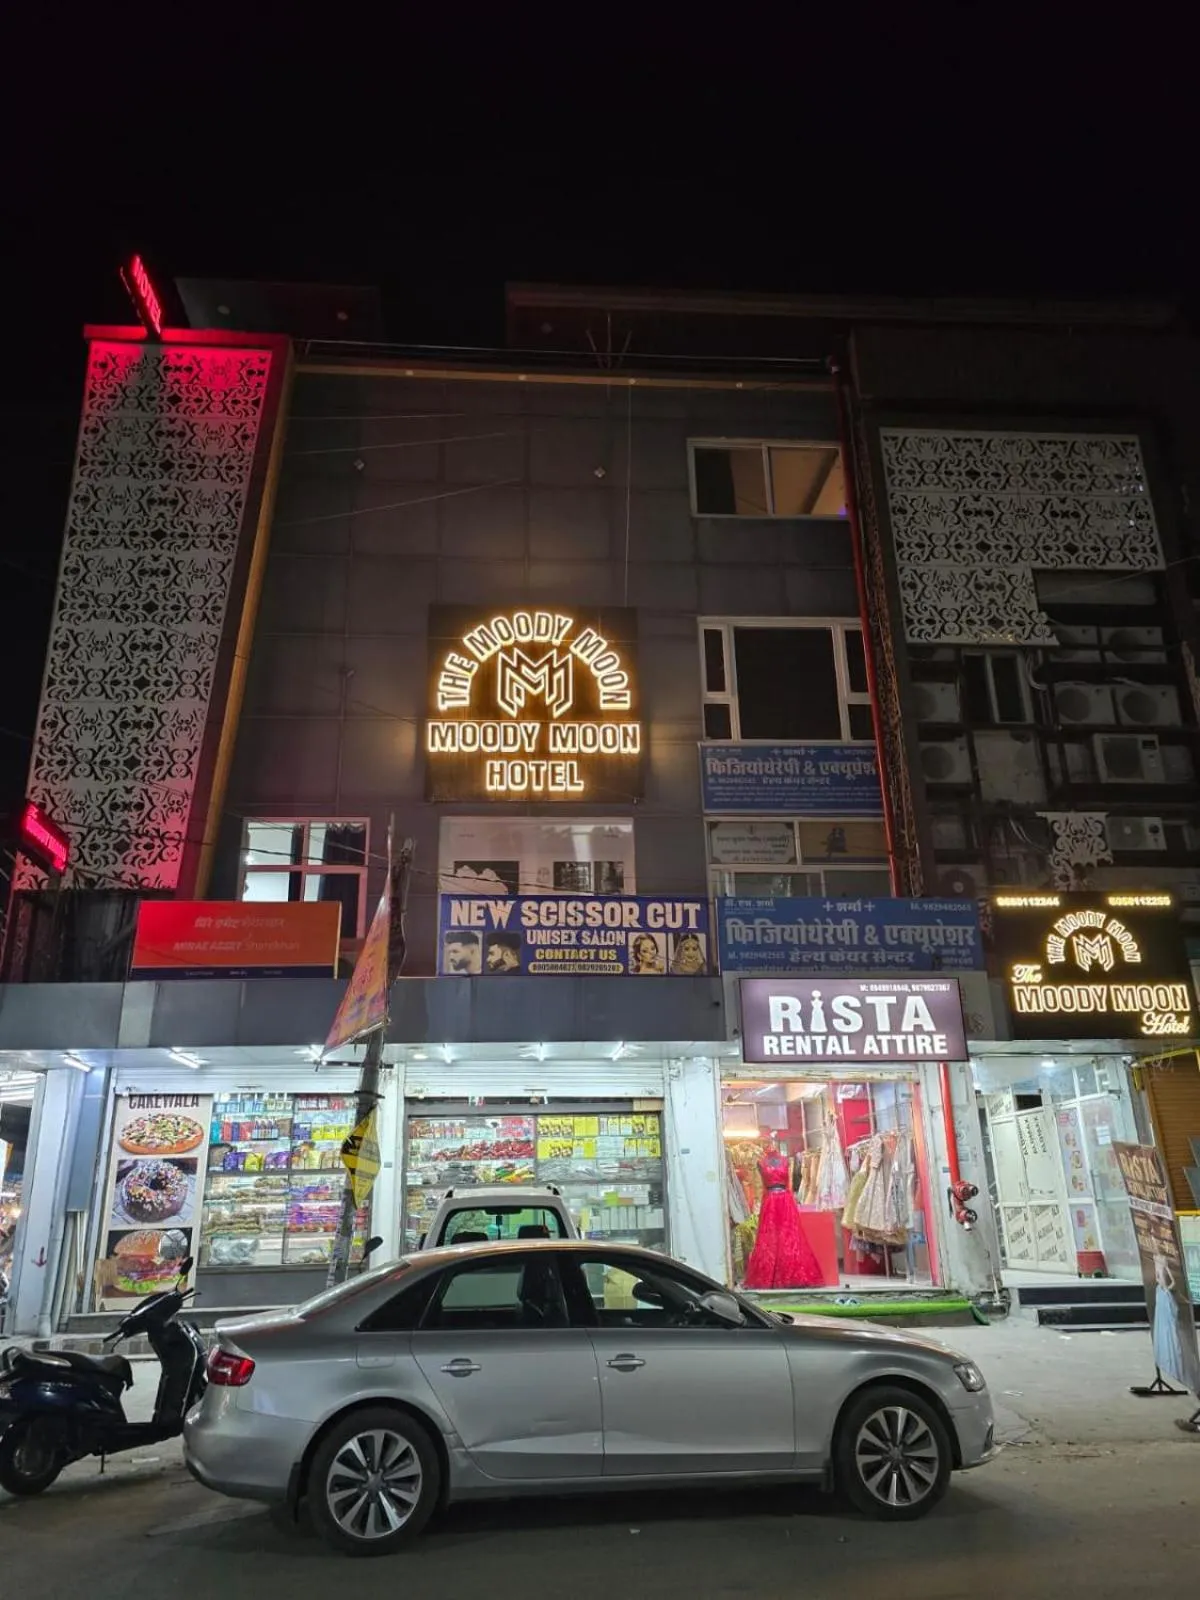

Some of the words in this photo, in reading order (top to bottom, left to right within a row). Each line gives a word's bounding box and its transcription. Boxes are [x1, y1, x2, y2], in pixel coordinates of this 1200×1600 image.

[438, 653, 478, 710] THE
[464, 612, 573, 661] MOODY
[570, 628, 631, 710] MOON
[428, 722, 541, 752] MOODY
[549, 723, 640, 754] MOON
[487, 760, 584, 791] HOTEL
[804, 760, 816, 775] &
[451, 900, 514, 929] NEW
[521, 901, 642, 928] SCISSOR
[646, 902, 701, 929] CUT
[1053, 910, 1106, 938] MOODY
[526, 929, 580, 945] UNISEX
[581, 929, 626, 945] SALON
[725, 918, 859, 946] फिजियोथेरेपी
[864, 922, 880, 945] &
[1106, 919, 1142, 963] MOON
[535, 948, 596, 960] CONTACT
[599, 949, 617, 960] US
[1046, 934, 1066, 964] THE
[1012, 964, 1042, 983] The
[1013, 985, 1107, 1013] MOODY
[1110, 984, 1190, 1012] MOON
[1141, 1012, 1190, 1034] Hotel
[763, 1034, 856, 1056] RENTAL
[863, 1034, 948, 1055] ATTIRE
[128, 1094, 200, 1109] CAKEWALA
